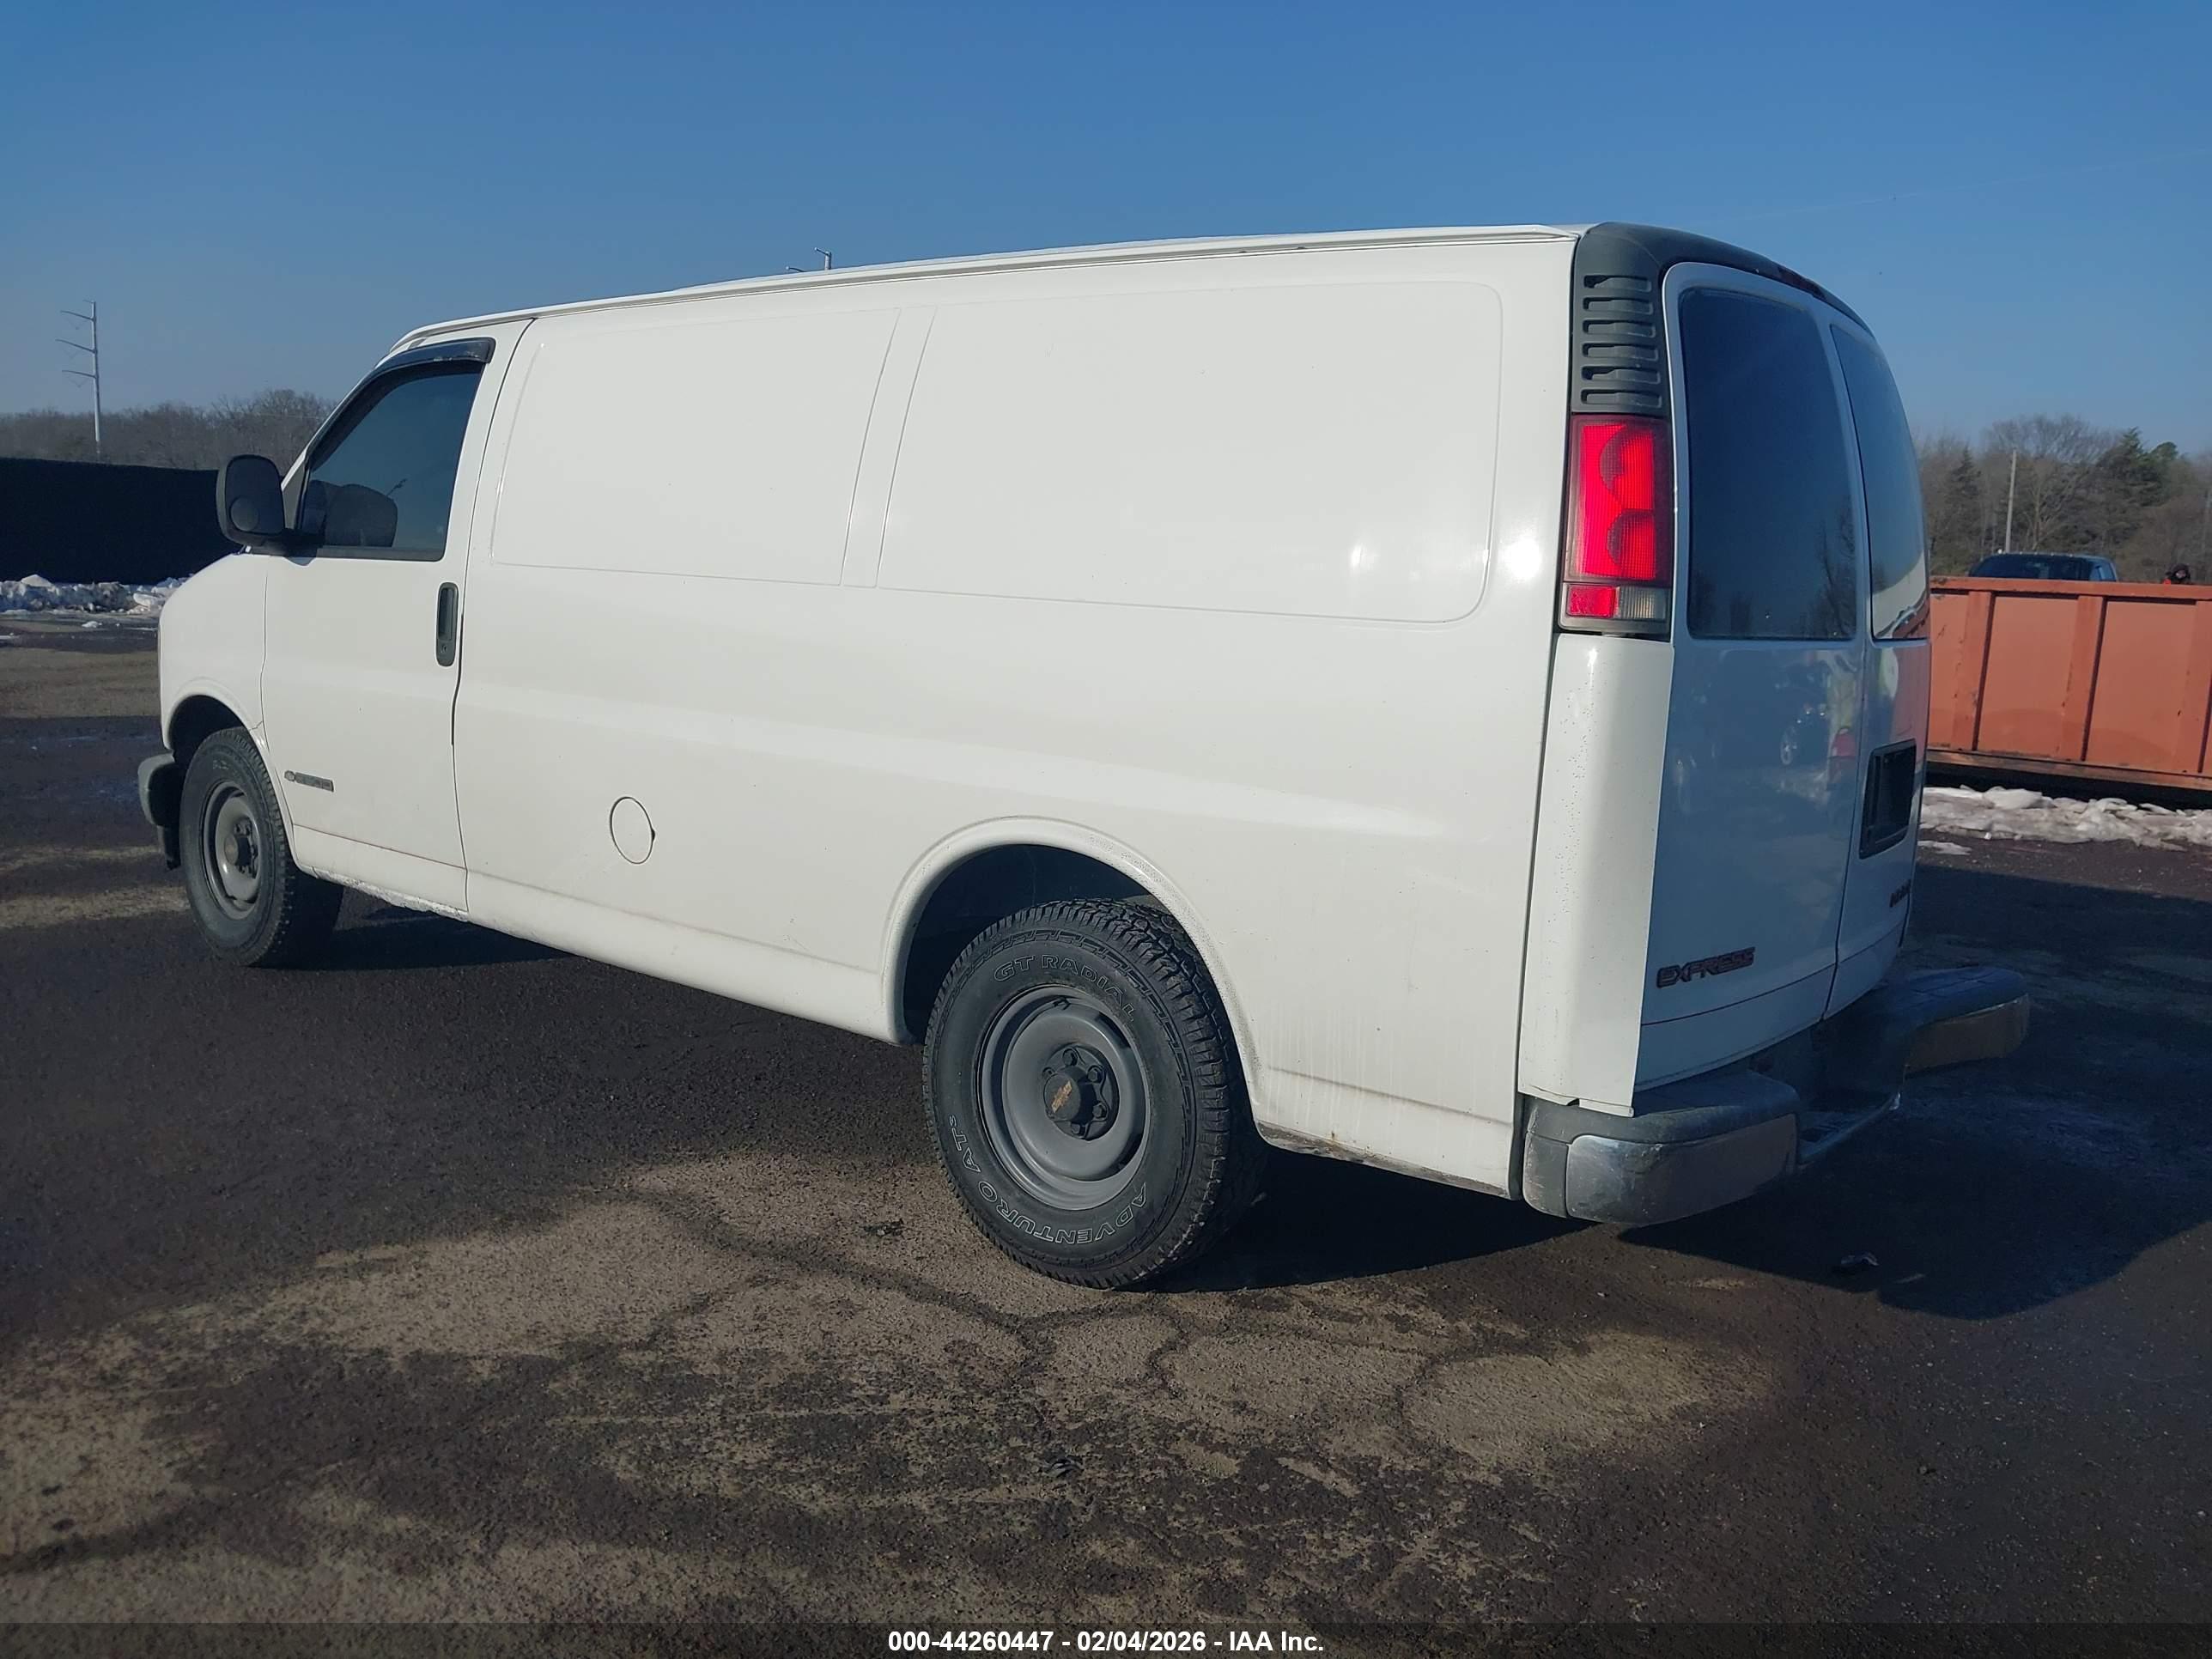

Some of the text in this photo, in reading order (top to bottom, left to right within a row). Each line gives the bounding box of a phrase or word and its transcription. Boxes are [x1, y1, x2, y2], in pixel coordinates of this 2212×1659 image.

[994, 954, 1134, 1022] GT RADIAL
[1656, 946, 1755, 988] EXPRESS
[979, 1182, 1147, 1243] ADVENTURO
